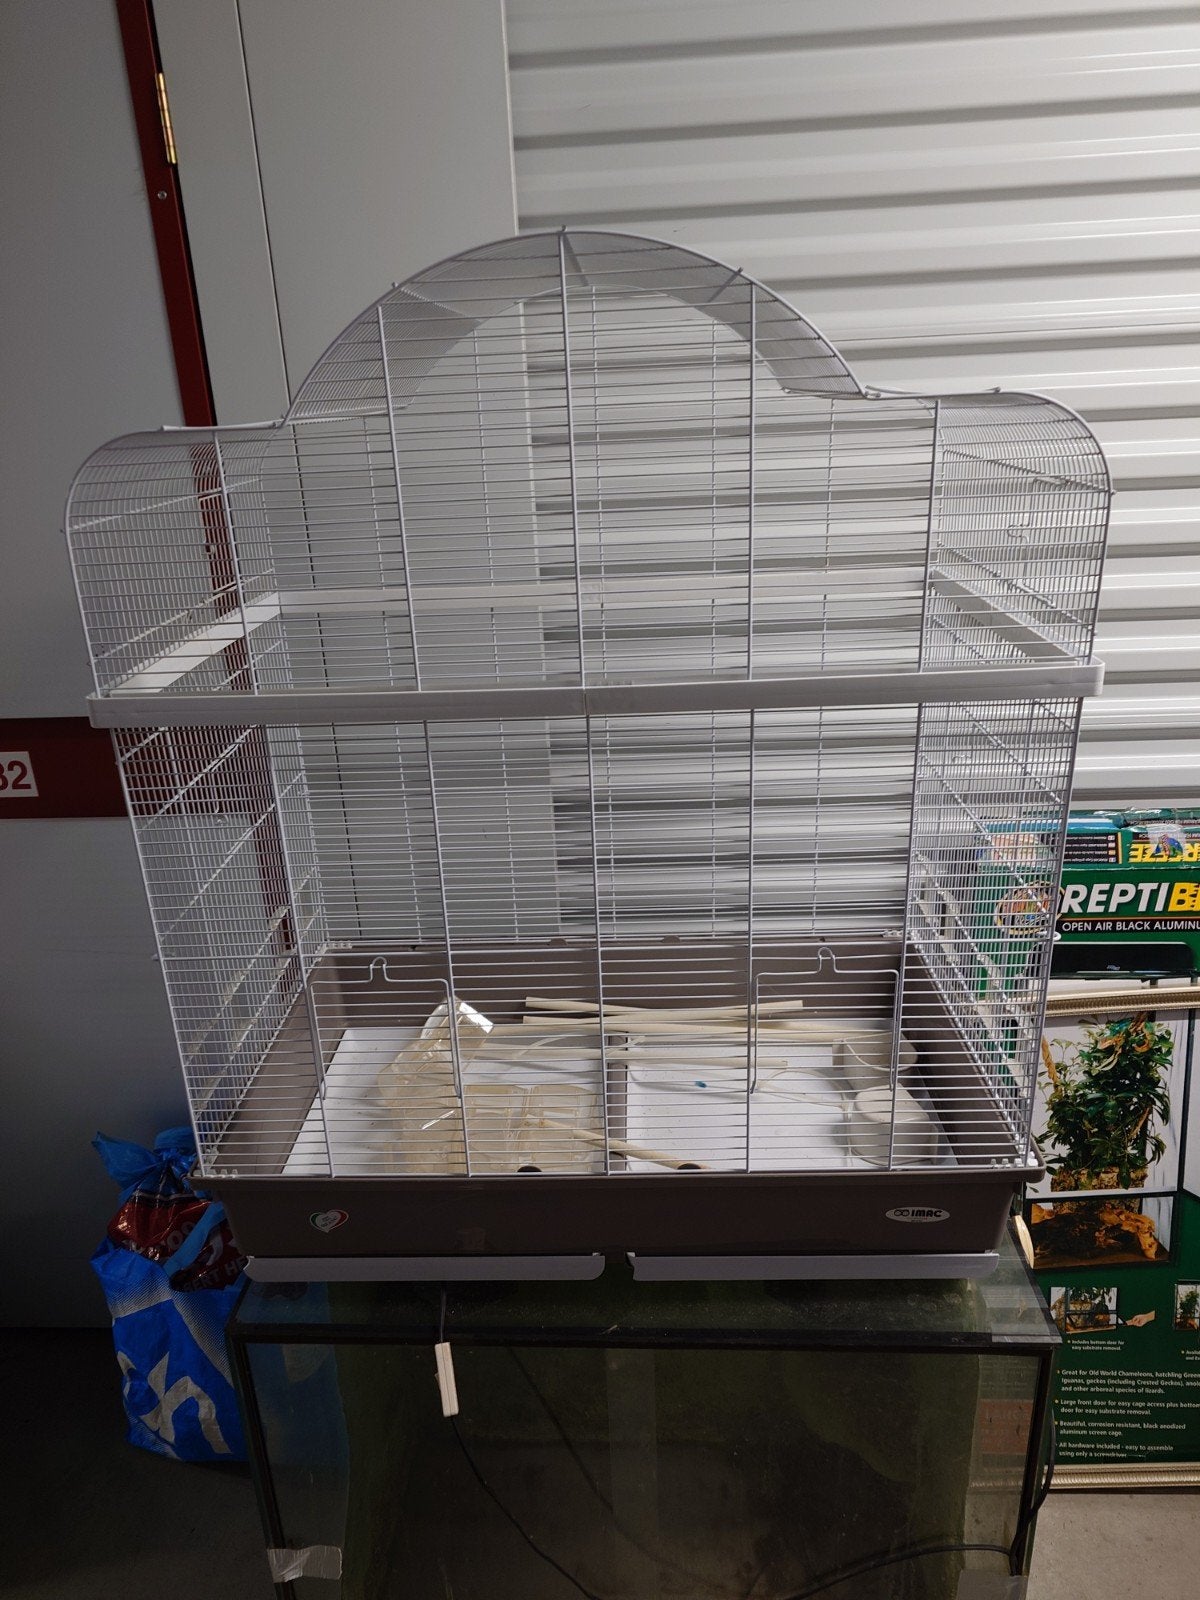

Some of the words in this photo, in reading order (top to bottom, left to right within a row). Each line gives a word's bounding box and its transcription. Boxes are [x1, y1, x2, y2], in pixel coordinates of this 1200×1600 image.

[1062, 922, 1092, 931] OPEN
[1095, 922, 1113, 931] AIR
[1116, 921, 1150, 931] BLACK
[911, 1209, 942, 1217] IMAC
[1155, 1371, 1182, 1379] hatchling
[1107, 1378, 1136, 1386] (including
[1166, 1401, 1178, 1409] plus
[1058, 1450, 1074, 1458] using
[1075, 1450, 1088, 1458] only
